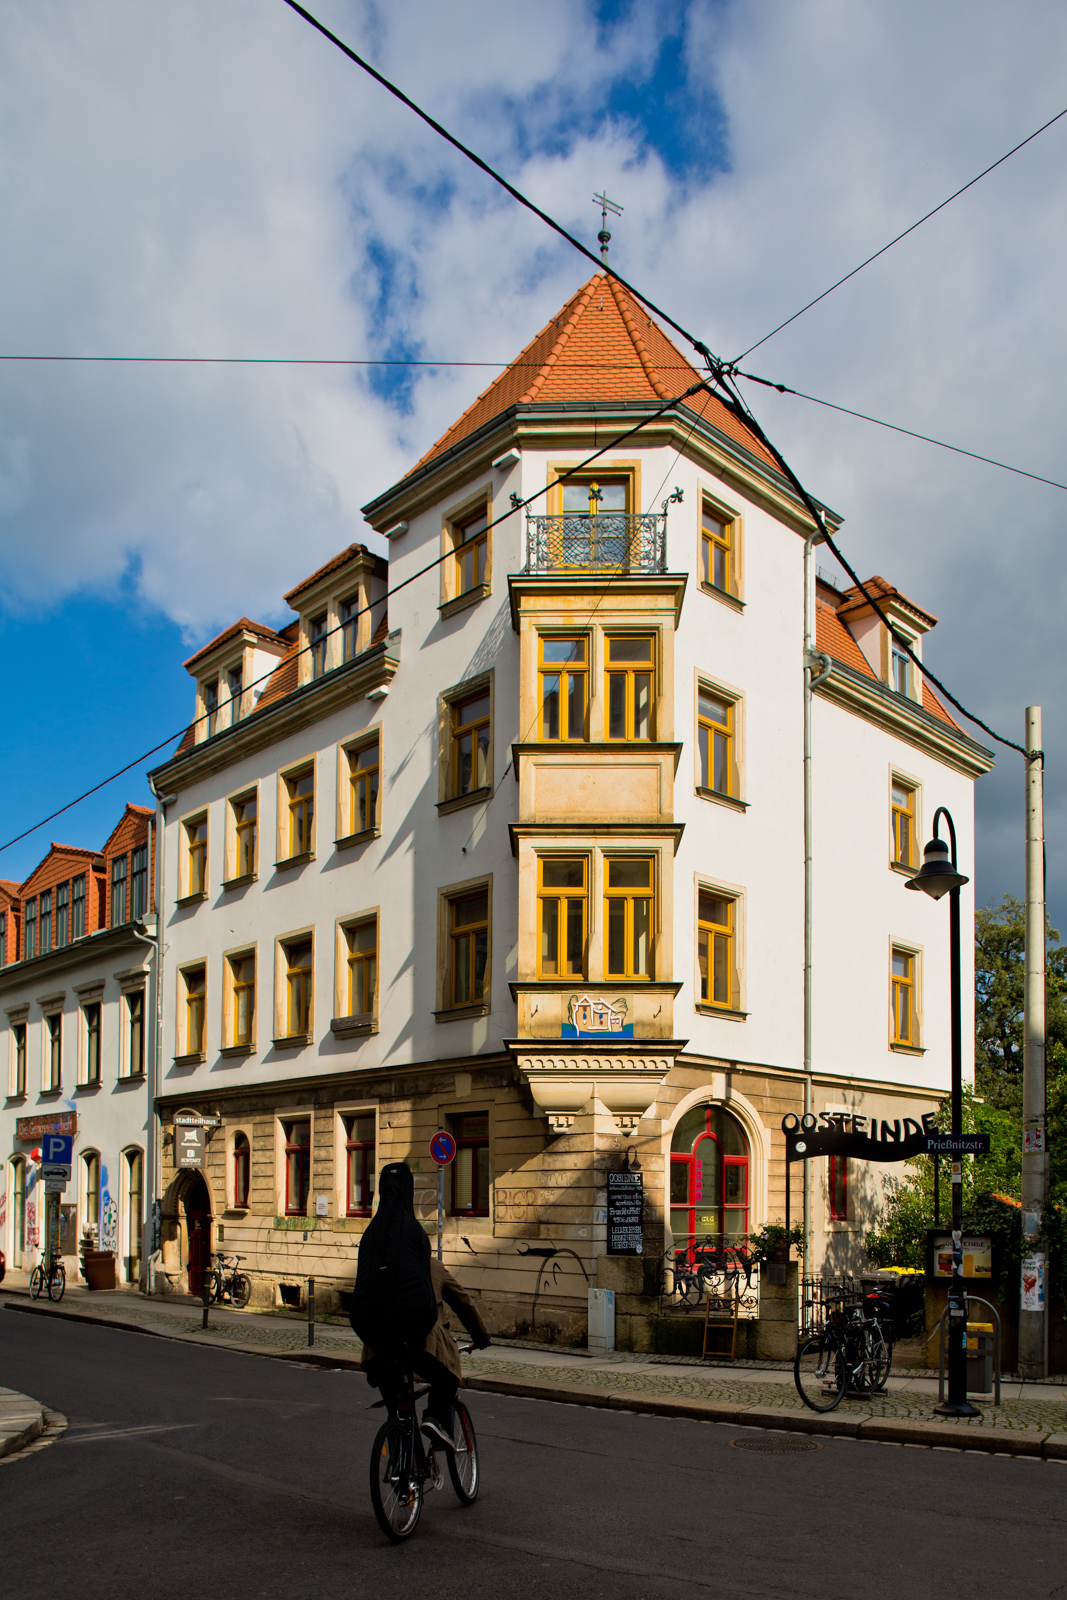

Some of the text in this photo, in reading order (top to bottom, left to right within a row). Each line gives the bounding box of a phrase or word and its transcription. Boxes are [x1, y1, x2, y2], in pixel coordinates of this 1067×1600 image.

[175, 1116, 217, 1125] stadtteilhaus
[782, 1112, 939, 1142] OOSTEINDE
[18, 1122, 29, 1136] Die
[49, 1138, 66, 1160] P
[926, 1139, 985, 1150] Prießnitzstr.
